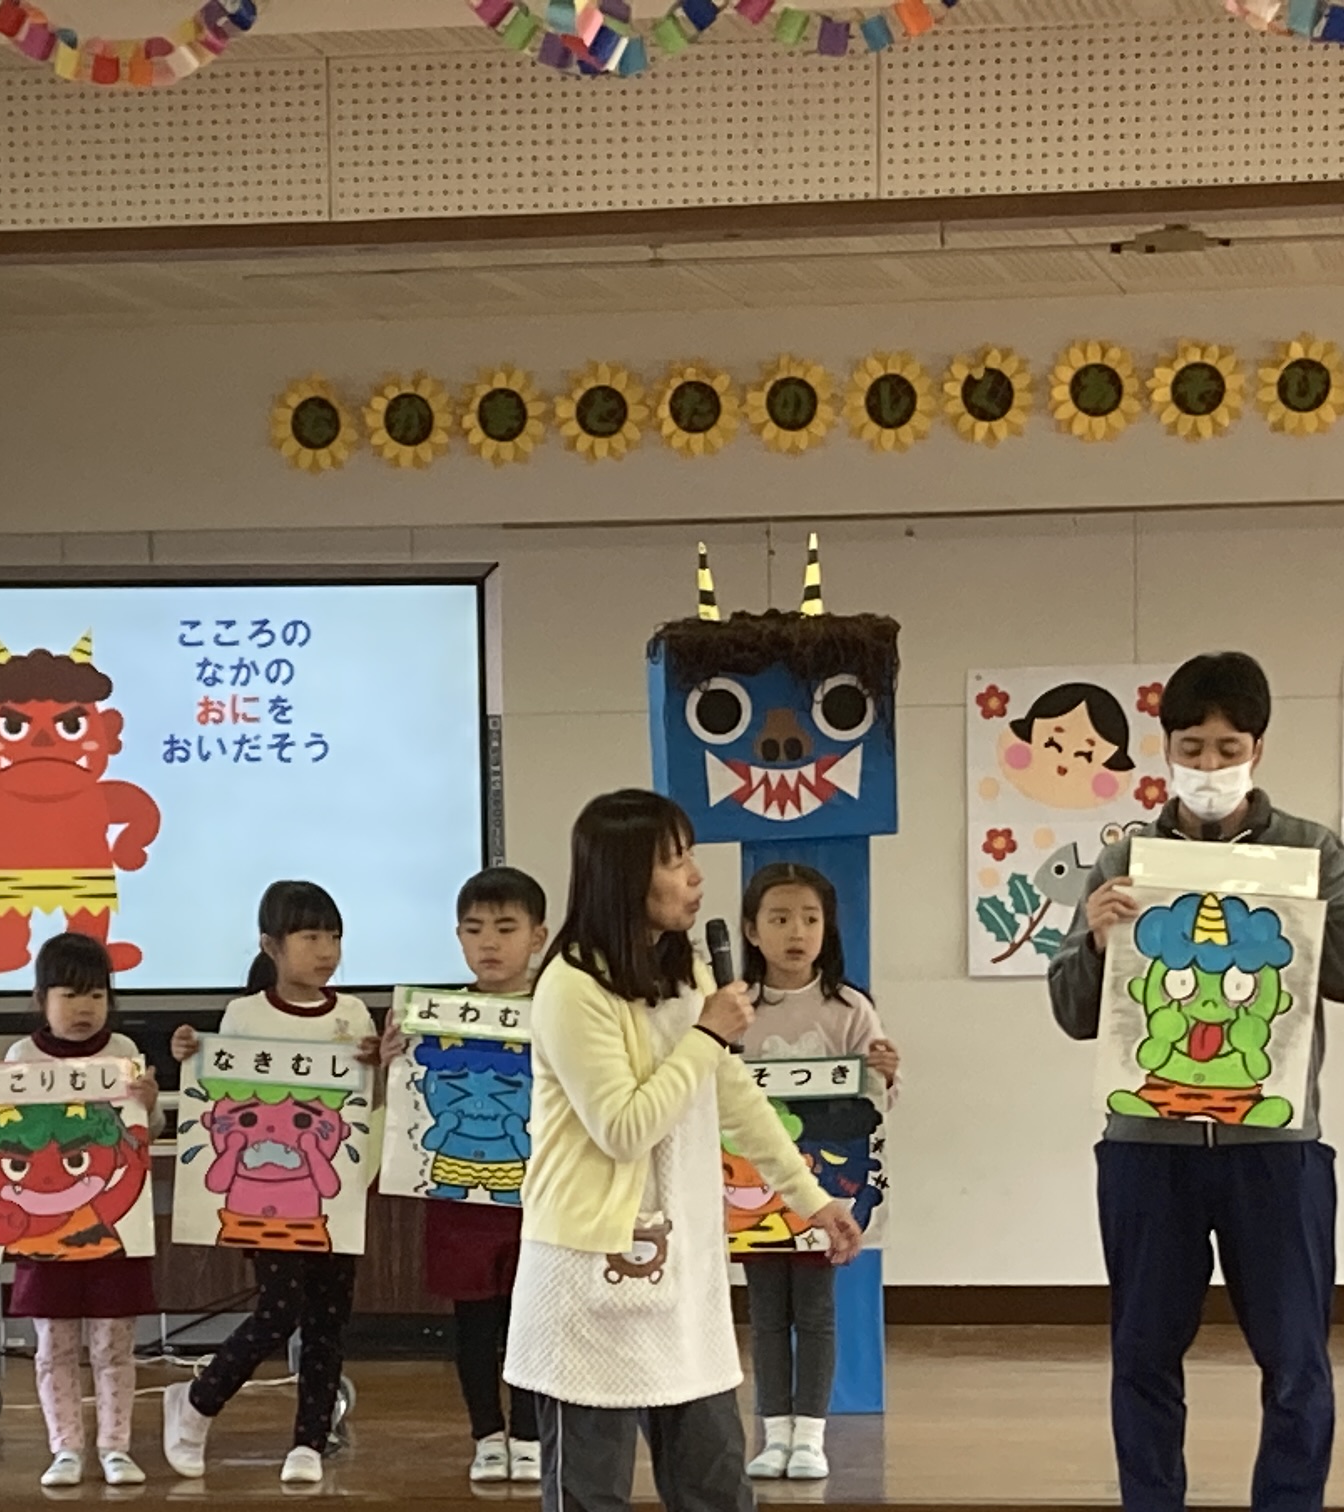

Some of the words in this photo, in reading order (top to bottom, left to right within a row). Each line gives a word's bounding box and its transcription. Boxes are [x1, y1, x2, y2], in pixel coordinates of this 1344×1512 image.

[178, 618, 312, 649] こころの
[196, 656, 295, 687] なかの
[196, 693, 294, 726] おにを
[162, 732, 330, 764] おいだそう
[418, 998, 521, 1028] よわむ
[213, 1048, 349, 1078] なきむし
[752, 1065, 849, 1087] そつき
